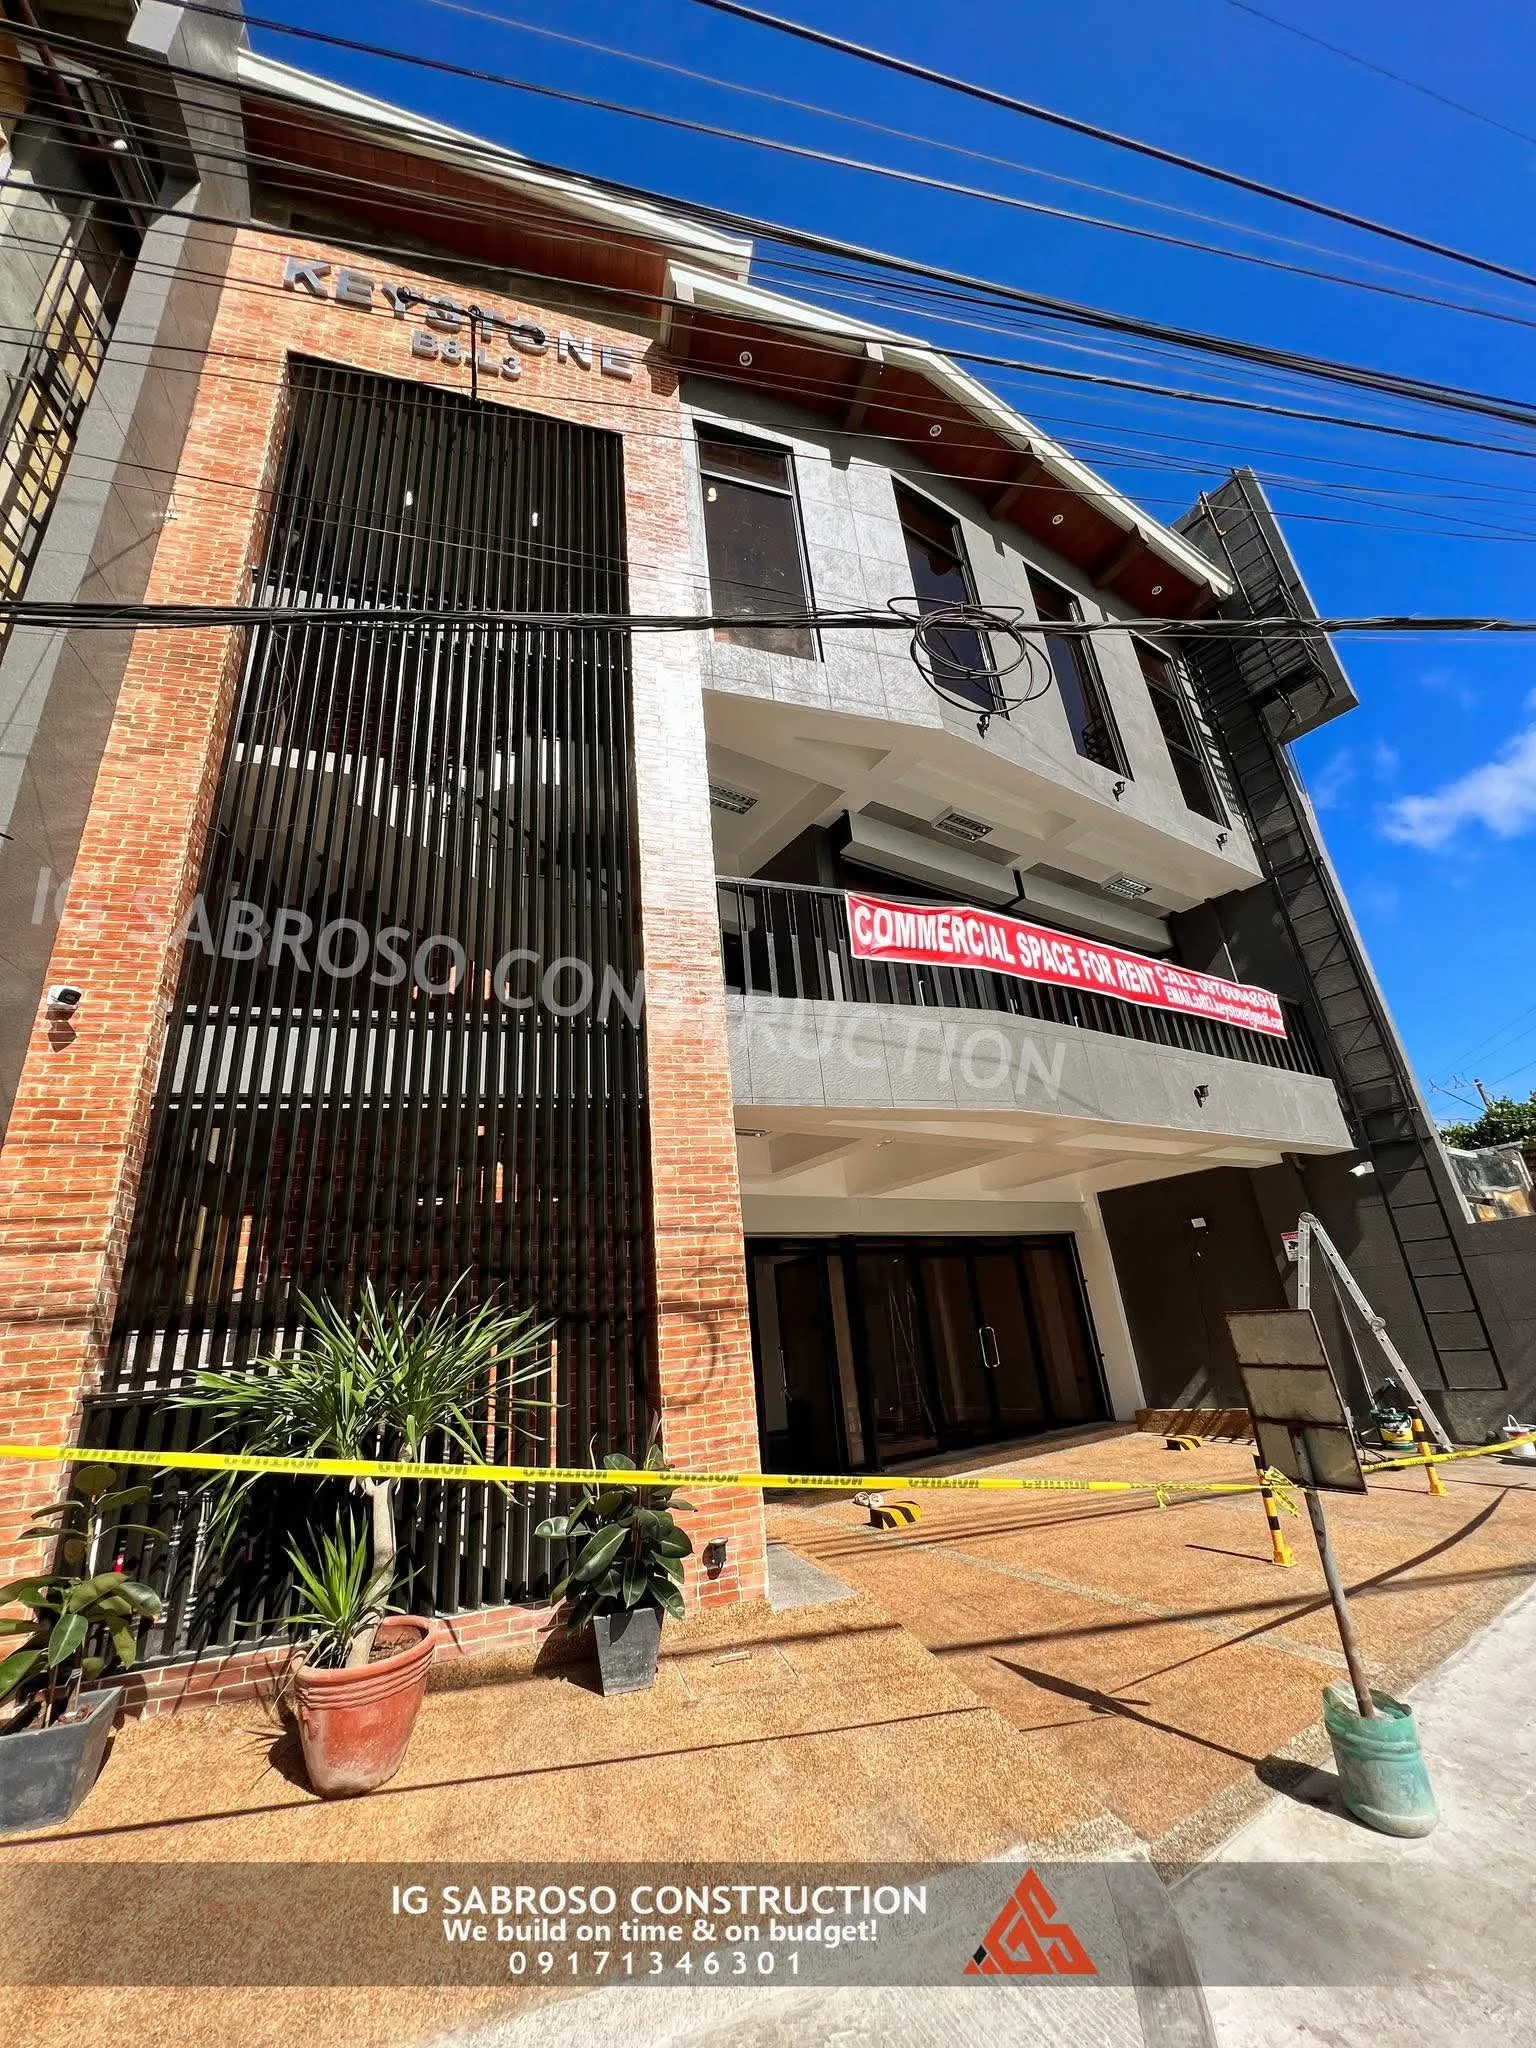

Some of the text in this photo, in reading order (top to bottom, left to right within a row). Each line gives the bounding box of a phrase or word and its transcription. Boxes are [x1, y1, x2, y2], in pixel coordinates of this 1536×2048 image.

[283, 255, 635, 382] KEYSTONE
[854, 905, 1161, 997] COMMERCIAL SPACE FOR RENT
[1154, 964, 1198, 990] CALL
